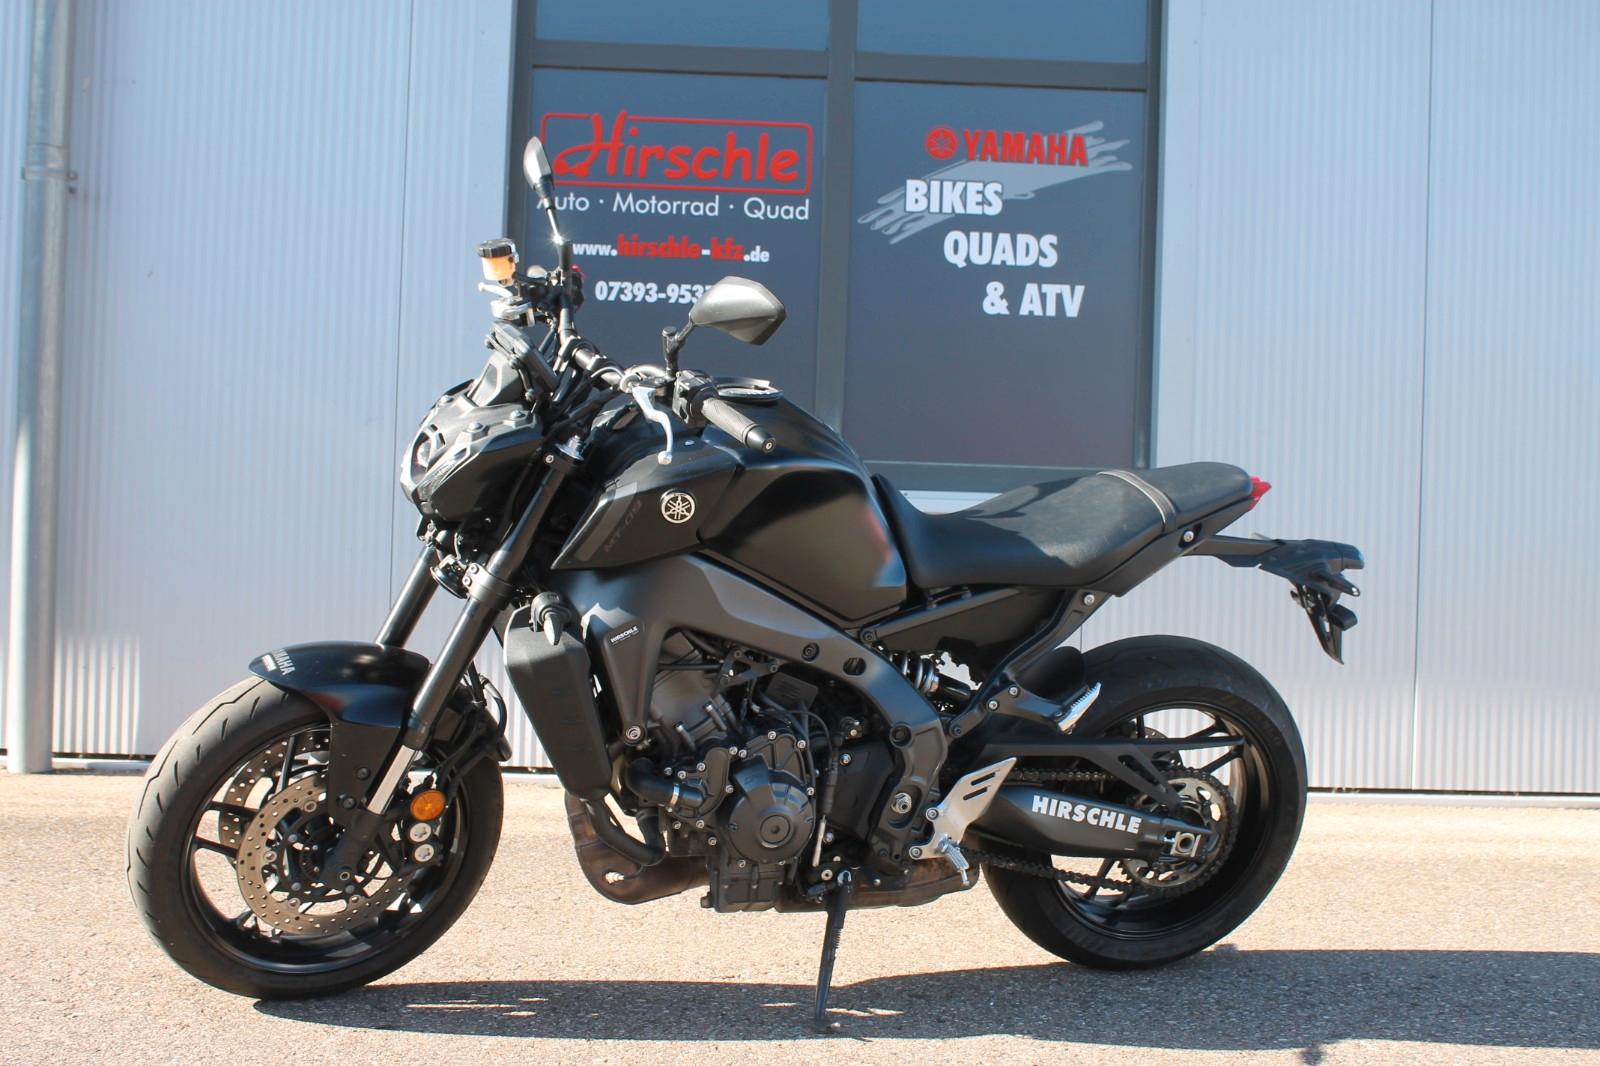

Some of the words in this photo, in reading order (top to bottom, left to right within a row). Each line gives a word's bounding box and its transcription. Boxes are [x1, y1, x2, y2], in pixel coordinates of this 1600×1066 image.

[552, 110, 800, 183] Hirschle
[963, 129, 1089, 167] YAMAHA
[612, 192, 720, 217] Motorrad
[743, 197, 810, 221] Quad
[905, 178, 1004, 216] BIKES
[571, 233, 770, 264] www.hirschle-kfz.de
[943, 230, 1059, 269] QUADS
[594, 280, 713, 304] 07393-953
[982, 281, 1010, 316] &
[1018, 283, 1086, 318] ATV
[1031, 794, 1143, 835] HIRSCHLE
